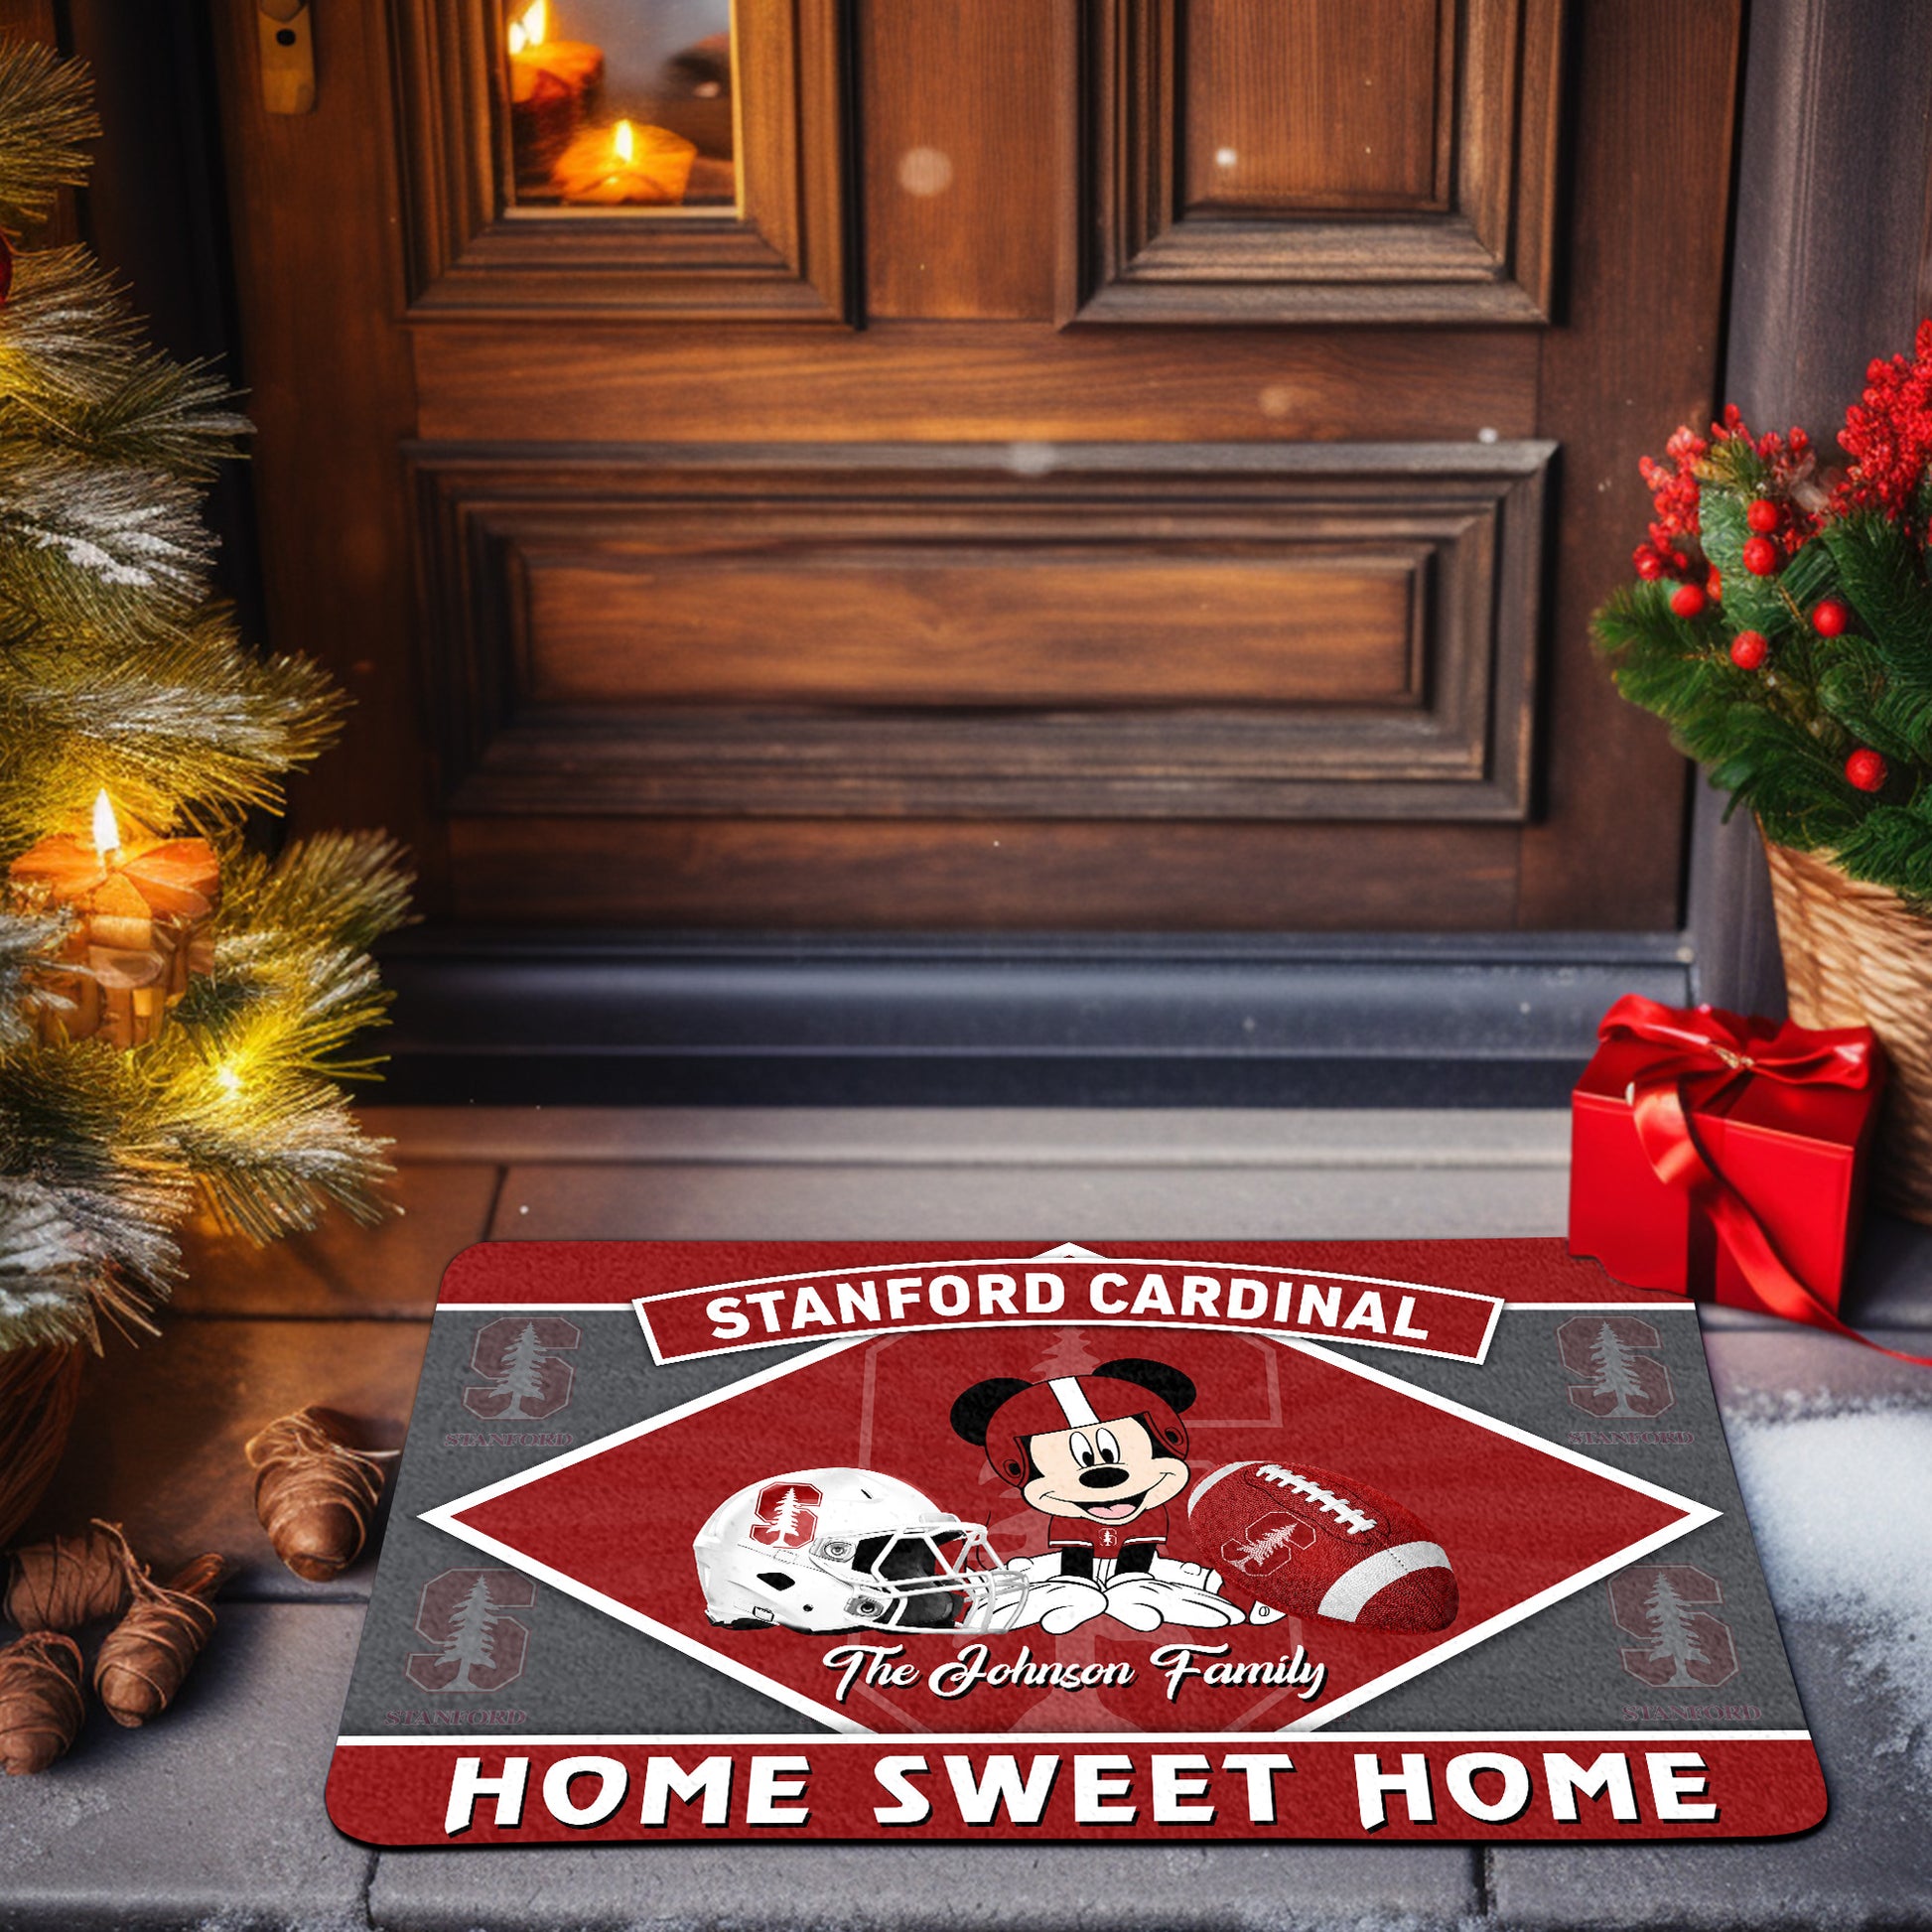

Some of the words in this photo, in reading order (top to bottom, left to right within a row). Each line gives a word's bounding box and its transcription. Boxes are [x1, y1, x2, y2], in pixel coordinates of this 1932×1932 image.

[706, 1272, 1065, 1339] STANFORD
[1090, 1272, 1430, 1340] CARDINAL
[444, 1433, 573, 1448] STANFORD
[1567, 1431, 1695, 1446] STANFORD
[822, 1643, 920, 1703] The
[928, 1643, 1134, 1701] Johnson
[1150, 1642, 1326, 1703] Family
[383, 1708, 528, 1726] STANFORD
[1621, 1704, 1762, 1722] STANFORD
[444, 1755, 812, 1836] HOME
[872, 1753, 1295, 1828] SWEET
[1353, 1751, 1720, 1833] HOME
